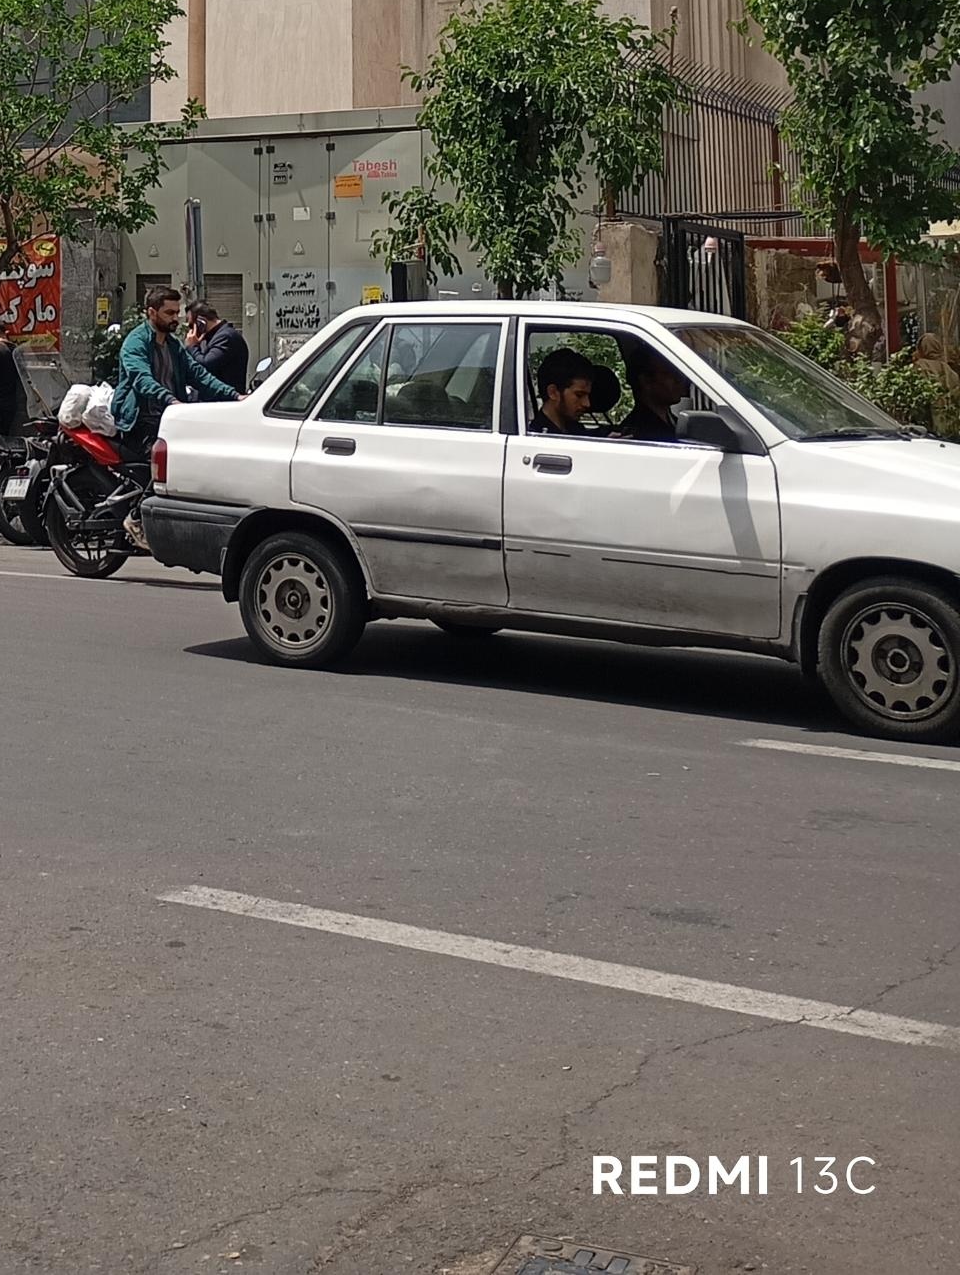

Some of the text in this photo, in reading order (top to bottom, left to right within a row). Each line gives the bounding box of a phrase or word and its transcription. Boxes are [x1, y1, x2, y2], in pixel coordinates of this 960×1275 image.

[352, 159, 397, 173] Tabesh
[275, 304, 320, 317] وکیل دادگستری
